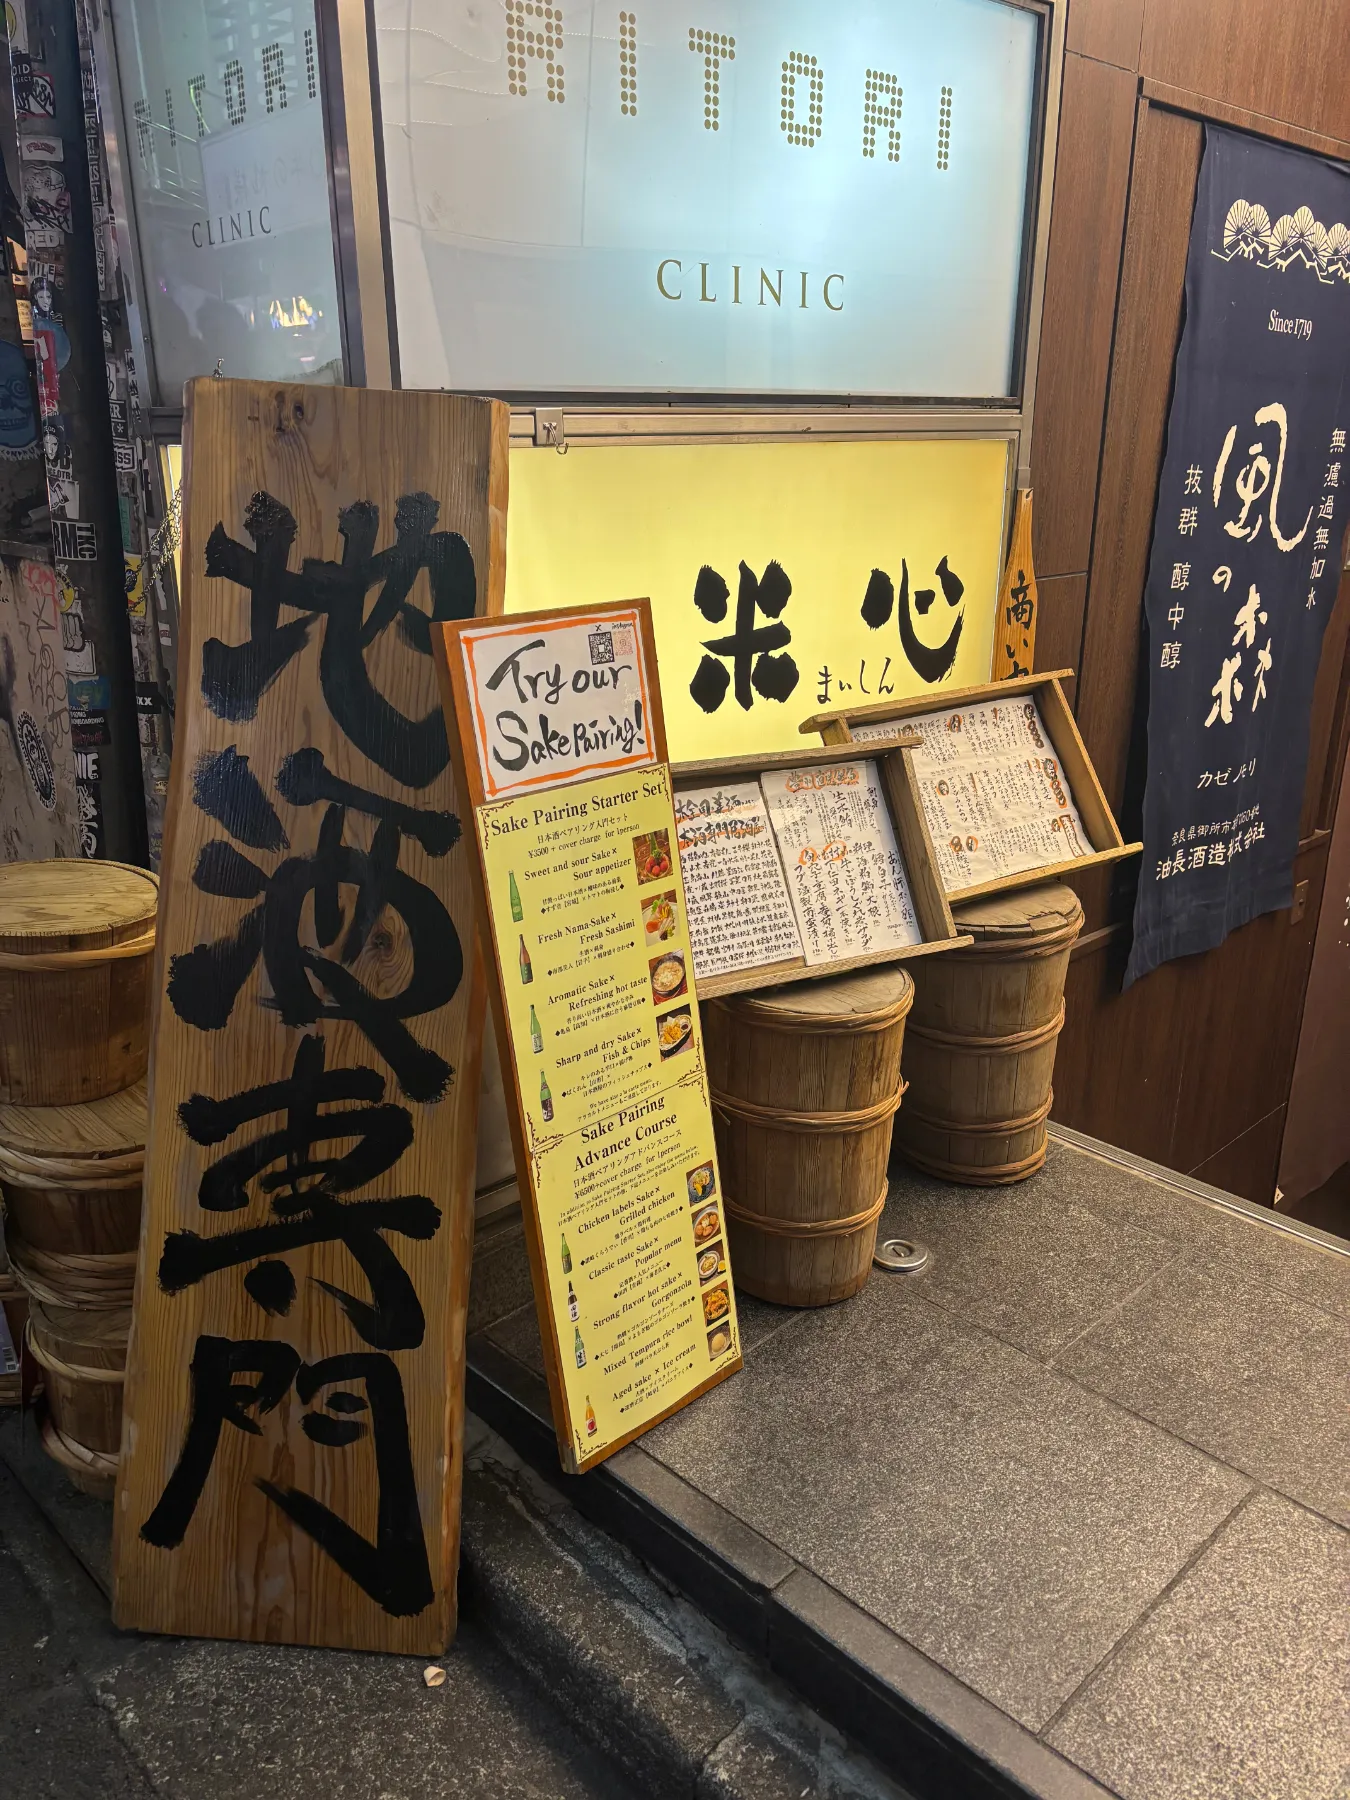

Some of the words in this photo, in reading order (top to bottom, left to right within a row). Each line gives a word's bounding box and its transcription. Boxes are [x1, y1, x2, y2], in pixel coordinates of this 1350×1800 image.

[191, 205, 273, 249] CLINIC
[656, 259, 845, 311] CLINIC
[1267, 308, 1294, 334] Since
[1293, 318, 1313, 341] 1719
[689, 554, 964, 714] 米心
[485, 639, 568, 705] Try
[571, 664, 633, 694] our
[816, 656, 895, 704] まいしん
[492, 710, 572, 773] Sake
[490, 815, 528, 836] Sake
[533, 802, 588, 825] Pairing
[591, 789, 638, 811] Starter
[641, 782, 662, 798] Set
[558, 840, 578, 851] cover
[578, 834, 601, 846] charge
[604, 829, 615, 839] for
[523, 867, 550, 881] Sweet
[552, 859, 569, 873] and
[570, 856, 590, 868] sour
[572, 869, 593, 881] Sour
[595, 857, 632, 875] appetizer
[537, 928, 563, 944] Fresh
[579, 929, 604, 945] Fresh
[604, 918, 635, 936] Sashimi
[547, 985, 586, 1005] Aromatic
[568, 989, 614, 1011] Refreshing
[614, 983, 628, 994] hot
[629, 976, 648, 988] taste
[555, 1053, 581, 1068] Sharp
[583, 1043, 599, 1057] and
[600, 1039, 615, 1050] dry
[602, 1049, 620, 1063] Fish
[621, 1045, 629, 1055] &
[629, 1037, 651, 1051] Chips
[580, 1121, 614, 1144] Sake
[617, 1096, 665, 1127] Pairing
[574, 1136, 631, 1171] Advance
[635, 1113, 677, 1141] Course
[619, 1162, 642, 1178] charge
[645, 1154, 656, 1165] for
[577, 1213, 610, 1234] Chicken
[611, 1200, 635, 1217] labels
[618, 1205, 646, 1226] Grilled
[647, 1191, 675, 1211] chicken
[588, 1261, 615, 1280] Classic
[616, 1251, 635, 1265] taste
[634, 1247, 663, 1268] Popular
[663, 1235, 682, 1251] menu
[592, 1309, 620, 1330] Strong
[621, 1294, 646, 1313] flavor
[646, 1285, 659, 1298] hot
[650, 1279, 692, 1308] Gorgonzola
[603, 1355, 627, 1376] Mixed
[628, 1337, 661, 1360] Tempura
[661, 1327, 675, 1340] rice
[676, 1313, 693, 1330] bowl
[612, 1383, 632, 1402] Aged
[633, 1373, 652, 1389] sake
[662, 1358, 674, 1370] Ice
[674, 1343, 696, 1362] cream
